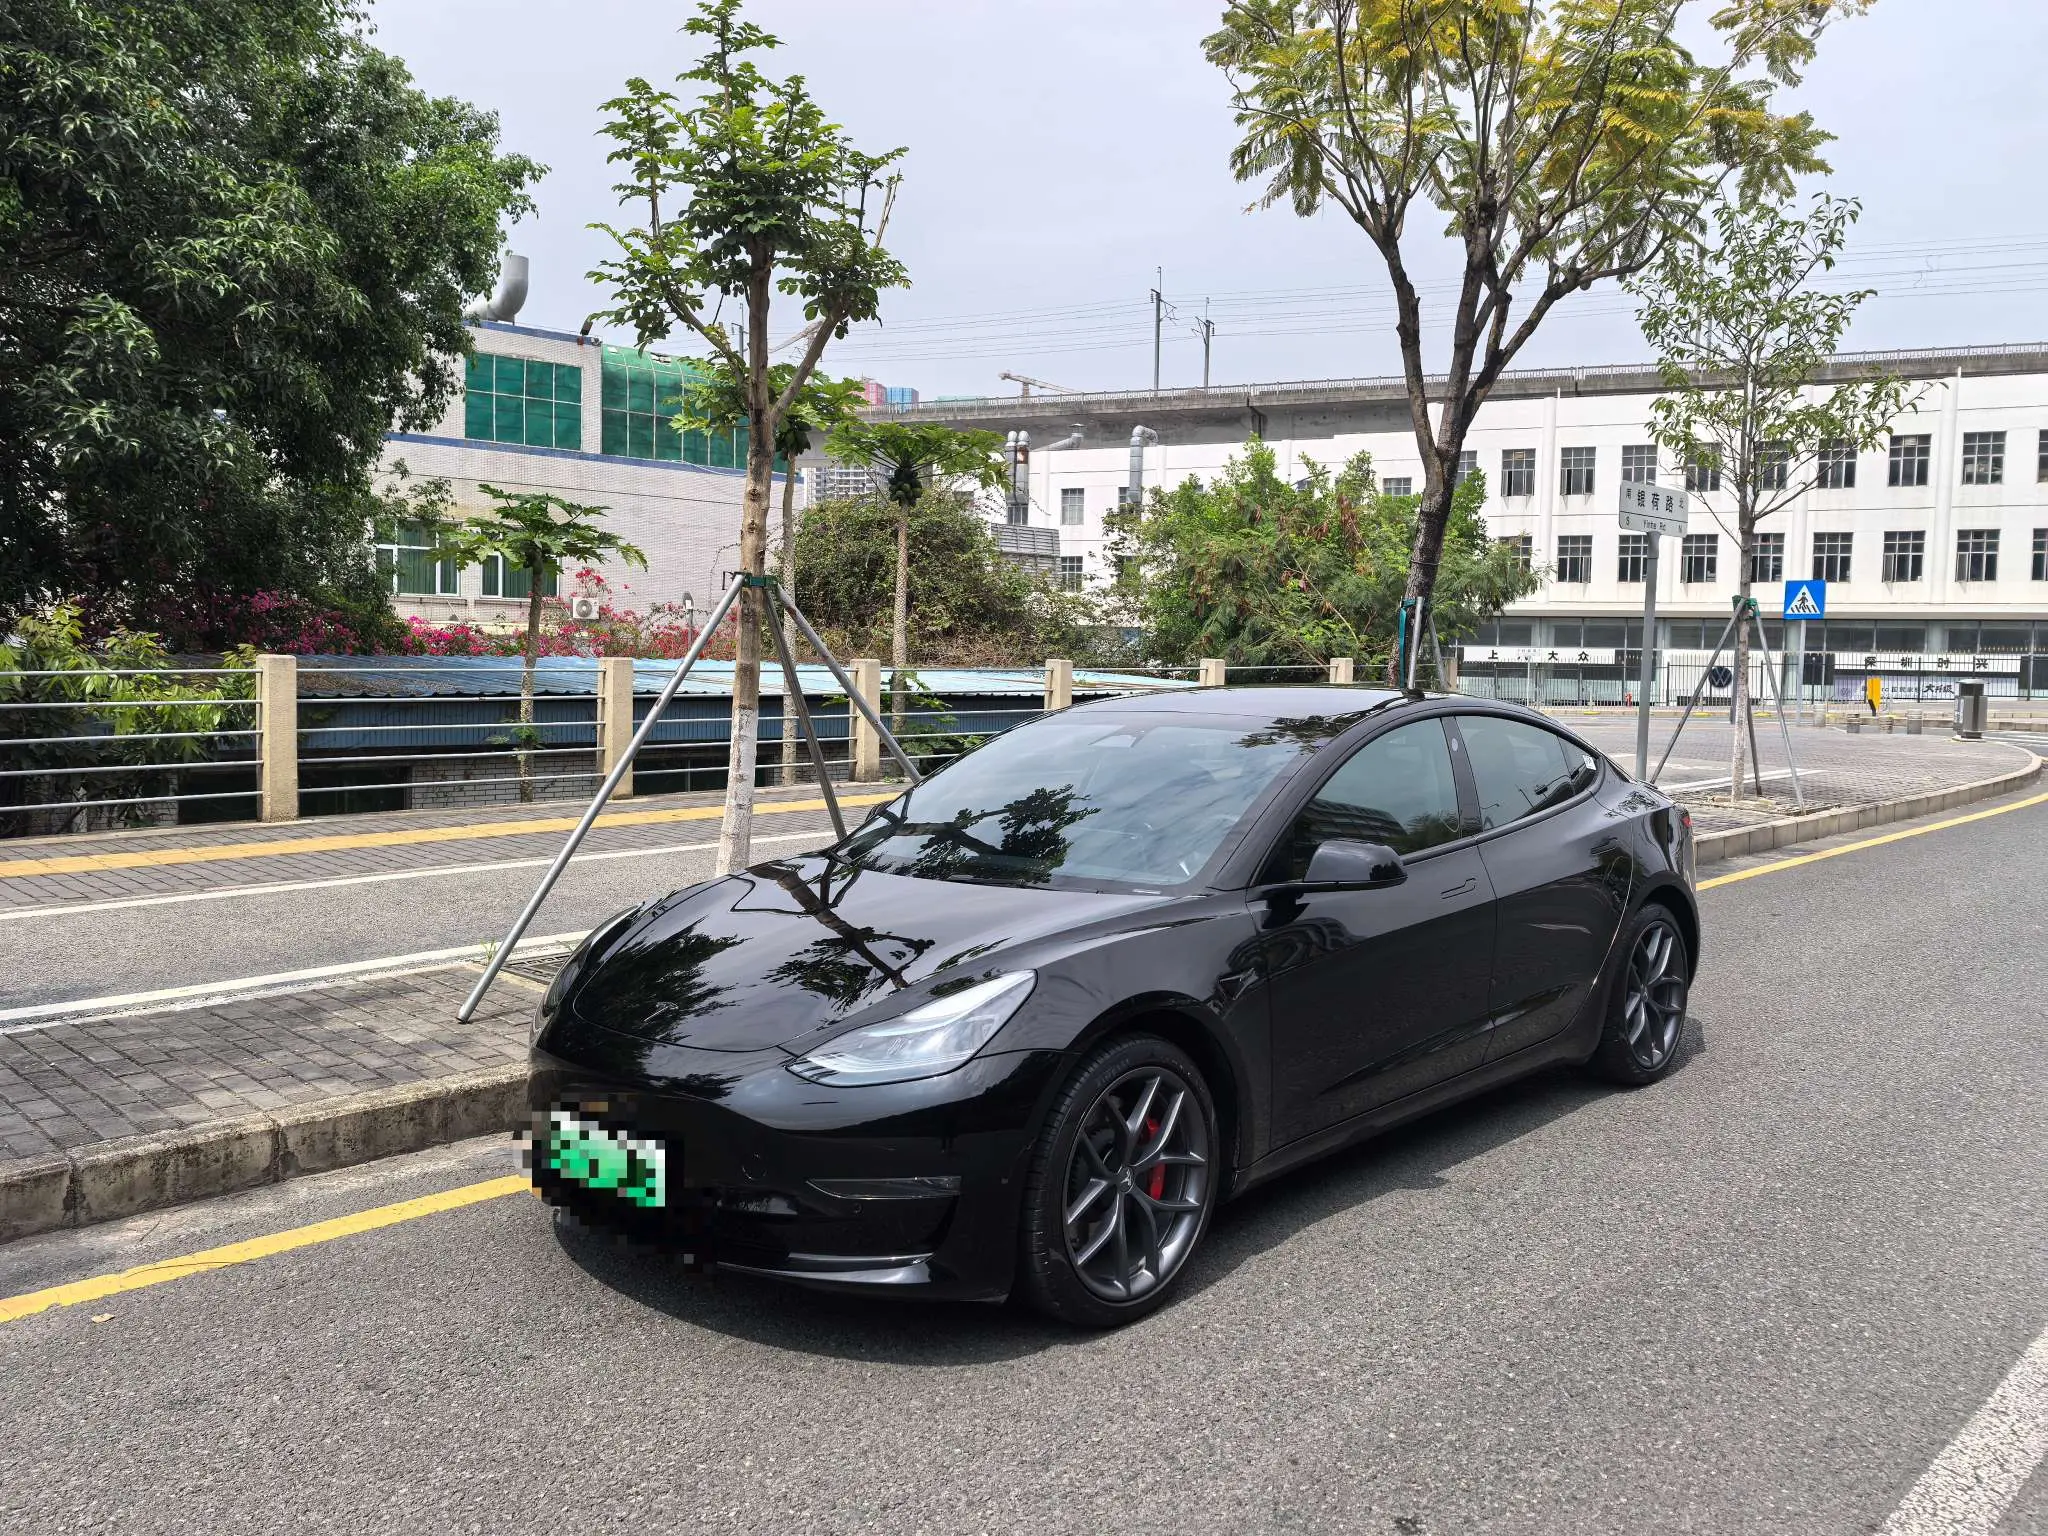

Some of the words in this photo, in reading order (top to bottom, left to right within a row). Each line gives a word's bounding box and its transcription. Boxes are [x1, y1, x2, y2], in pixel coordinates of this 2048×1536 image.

[1637, 489, 1674, 513] 银荷路
[1625, 516, 1631, 526] S
[1488, 650, 1590, 662] 上大众
